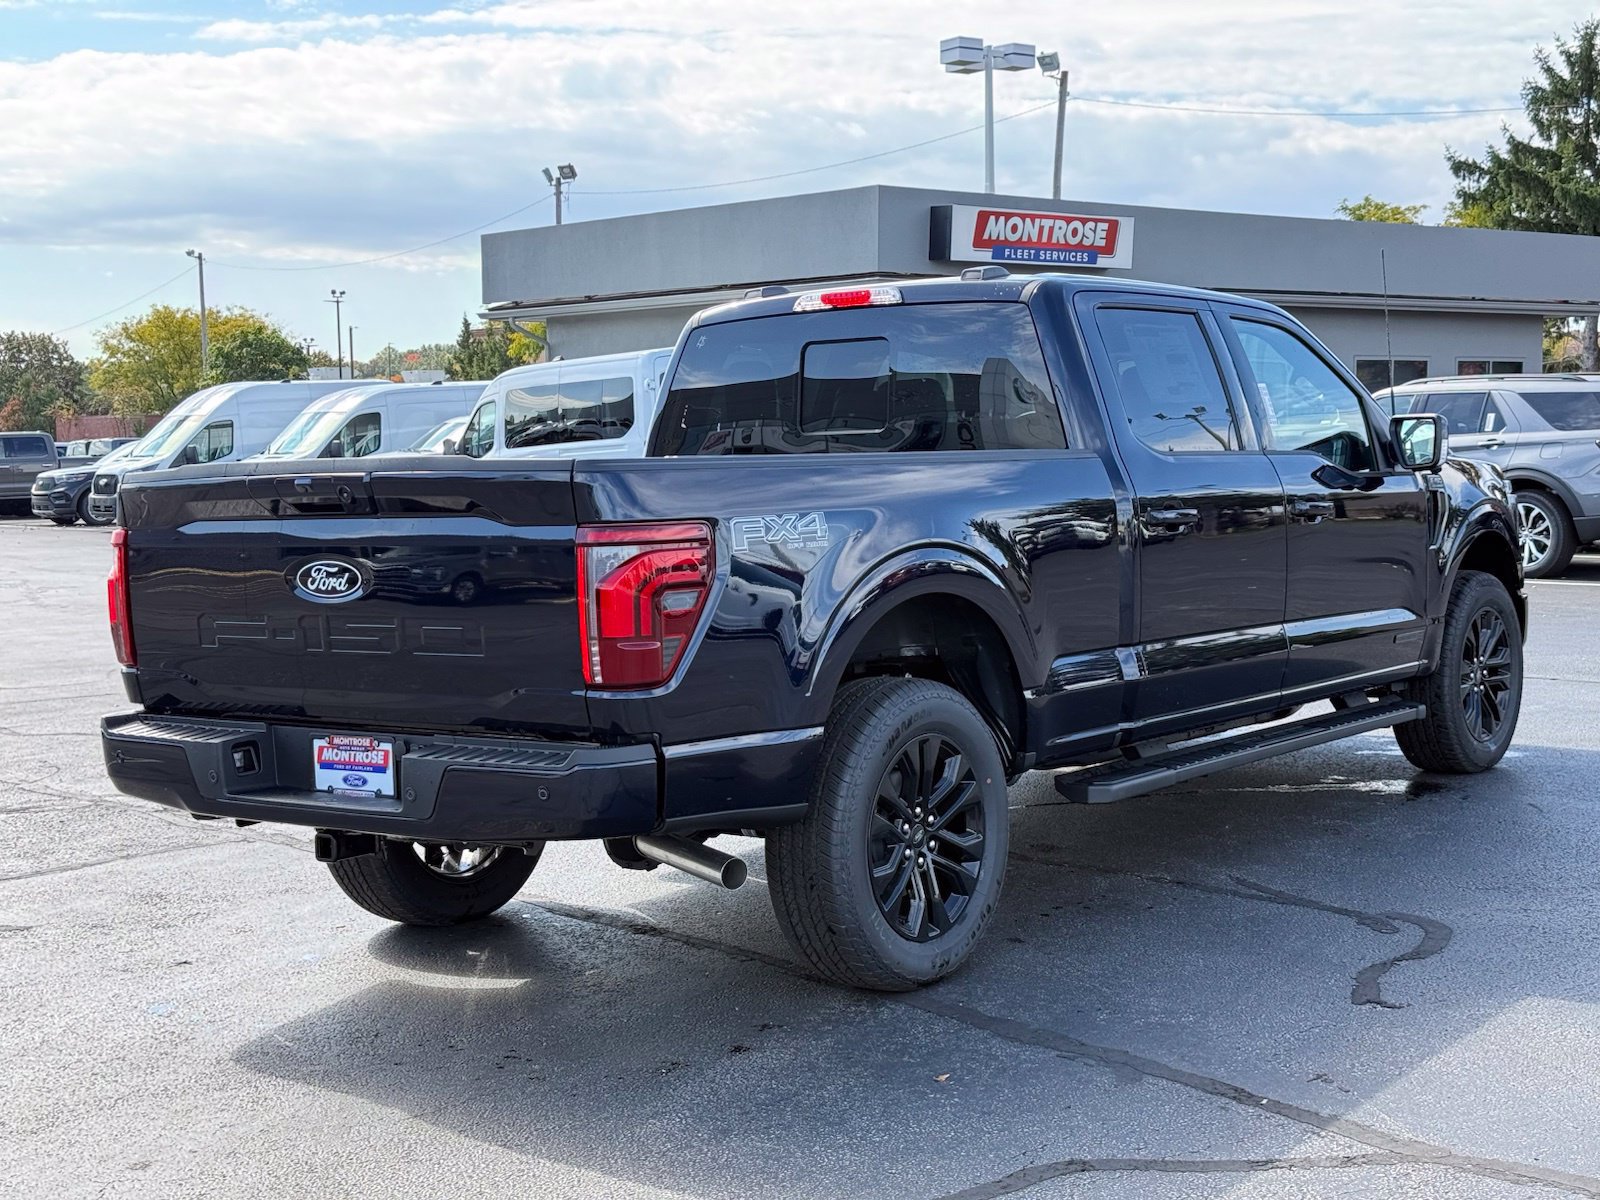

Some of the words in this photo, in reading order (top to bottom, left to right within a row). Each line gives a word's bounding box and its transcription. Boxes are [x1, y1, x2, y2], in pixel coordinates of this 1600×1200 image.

[982, 215, 1110, 247] MONTROSE
[1004, 248, 1036, 260] FLEET
[1039, 250, 1089, 262] SERVICES
[730, 512, 829, 554] FX4
[307, 565, 349, 592] Ford
[198, 612, 485, 658] F-150
[333, 736, 371, 747] MONTROSE
[321, 747, 385, 764] MONTROSE
[346, 774, 363, 787] Ford
